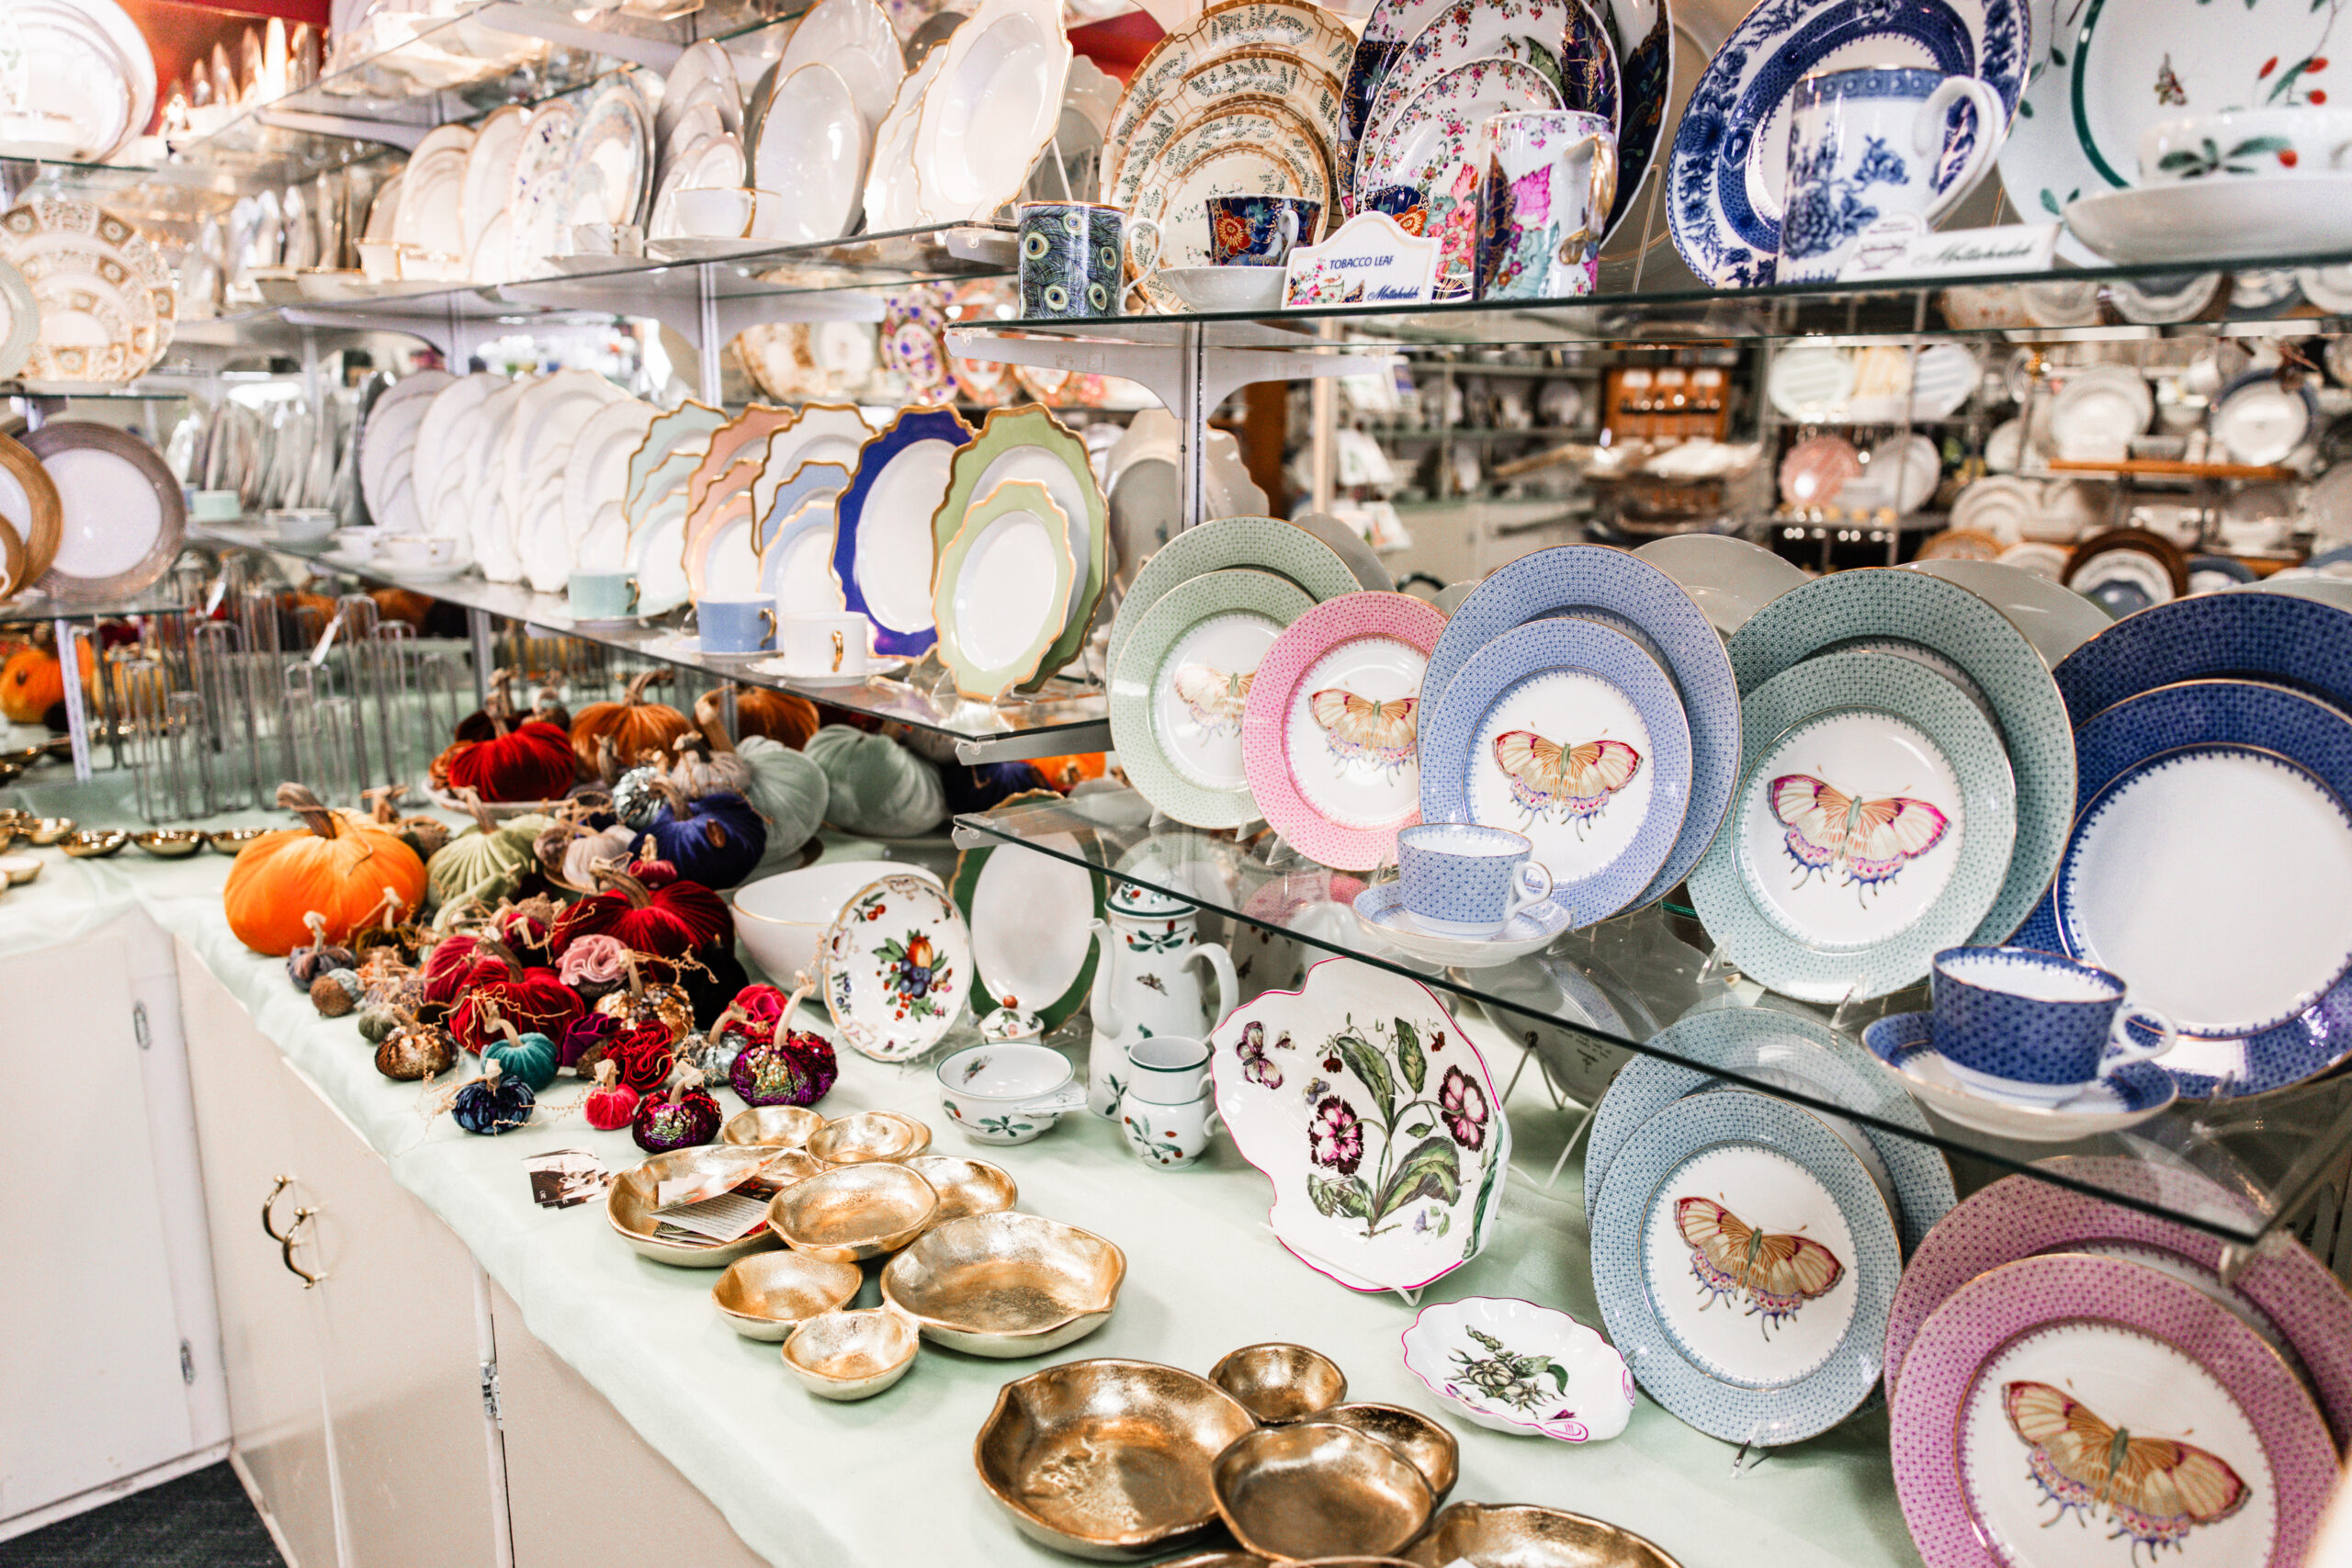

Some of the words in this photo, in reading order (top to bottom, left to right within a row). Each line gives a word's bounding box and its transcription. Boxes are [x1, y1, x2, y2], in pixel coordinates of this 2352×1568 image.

[1329, 257, 1373, 269] TOBACCO
[1374, 255, 1394, 265] LEAF
[1367, 285, 1419, 300] Mottahedeh
